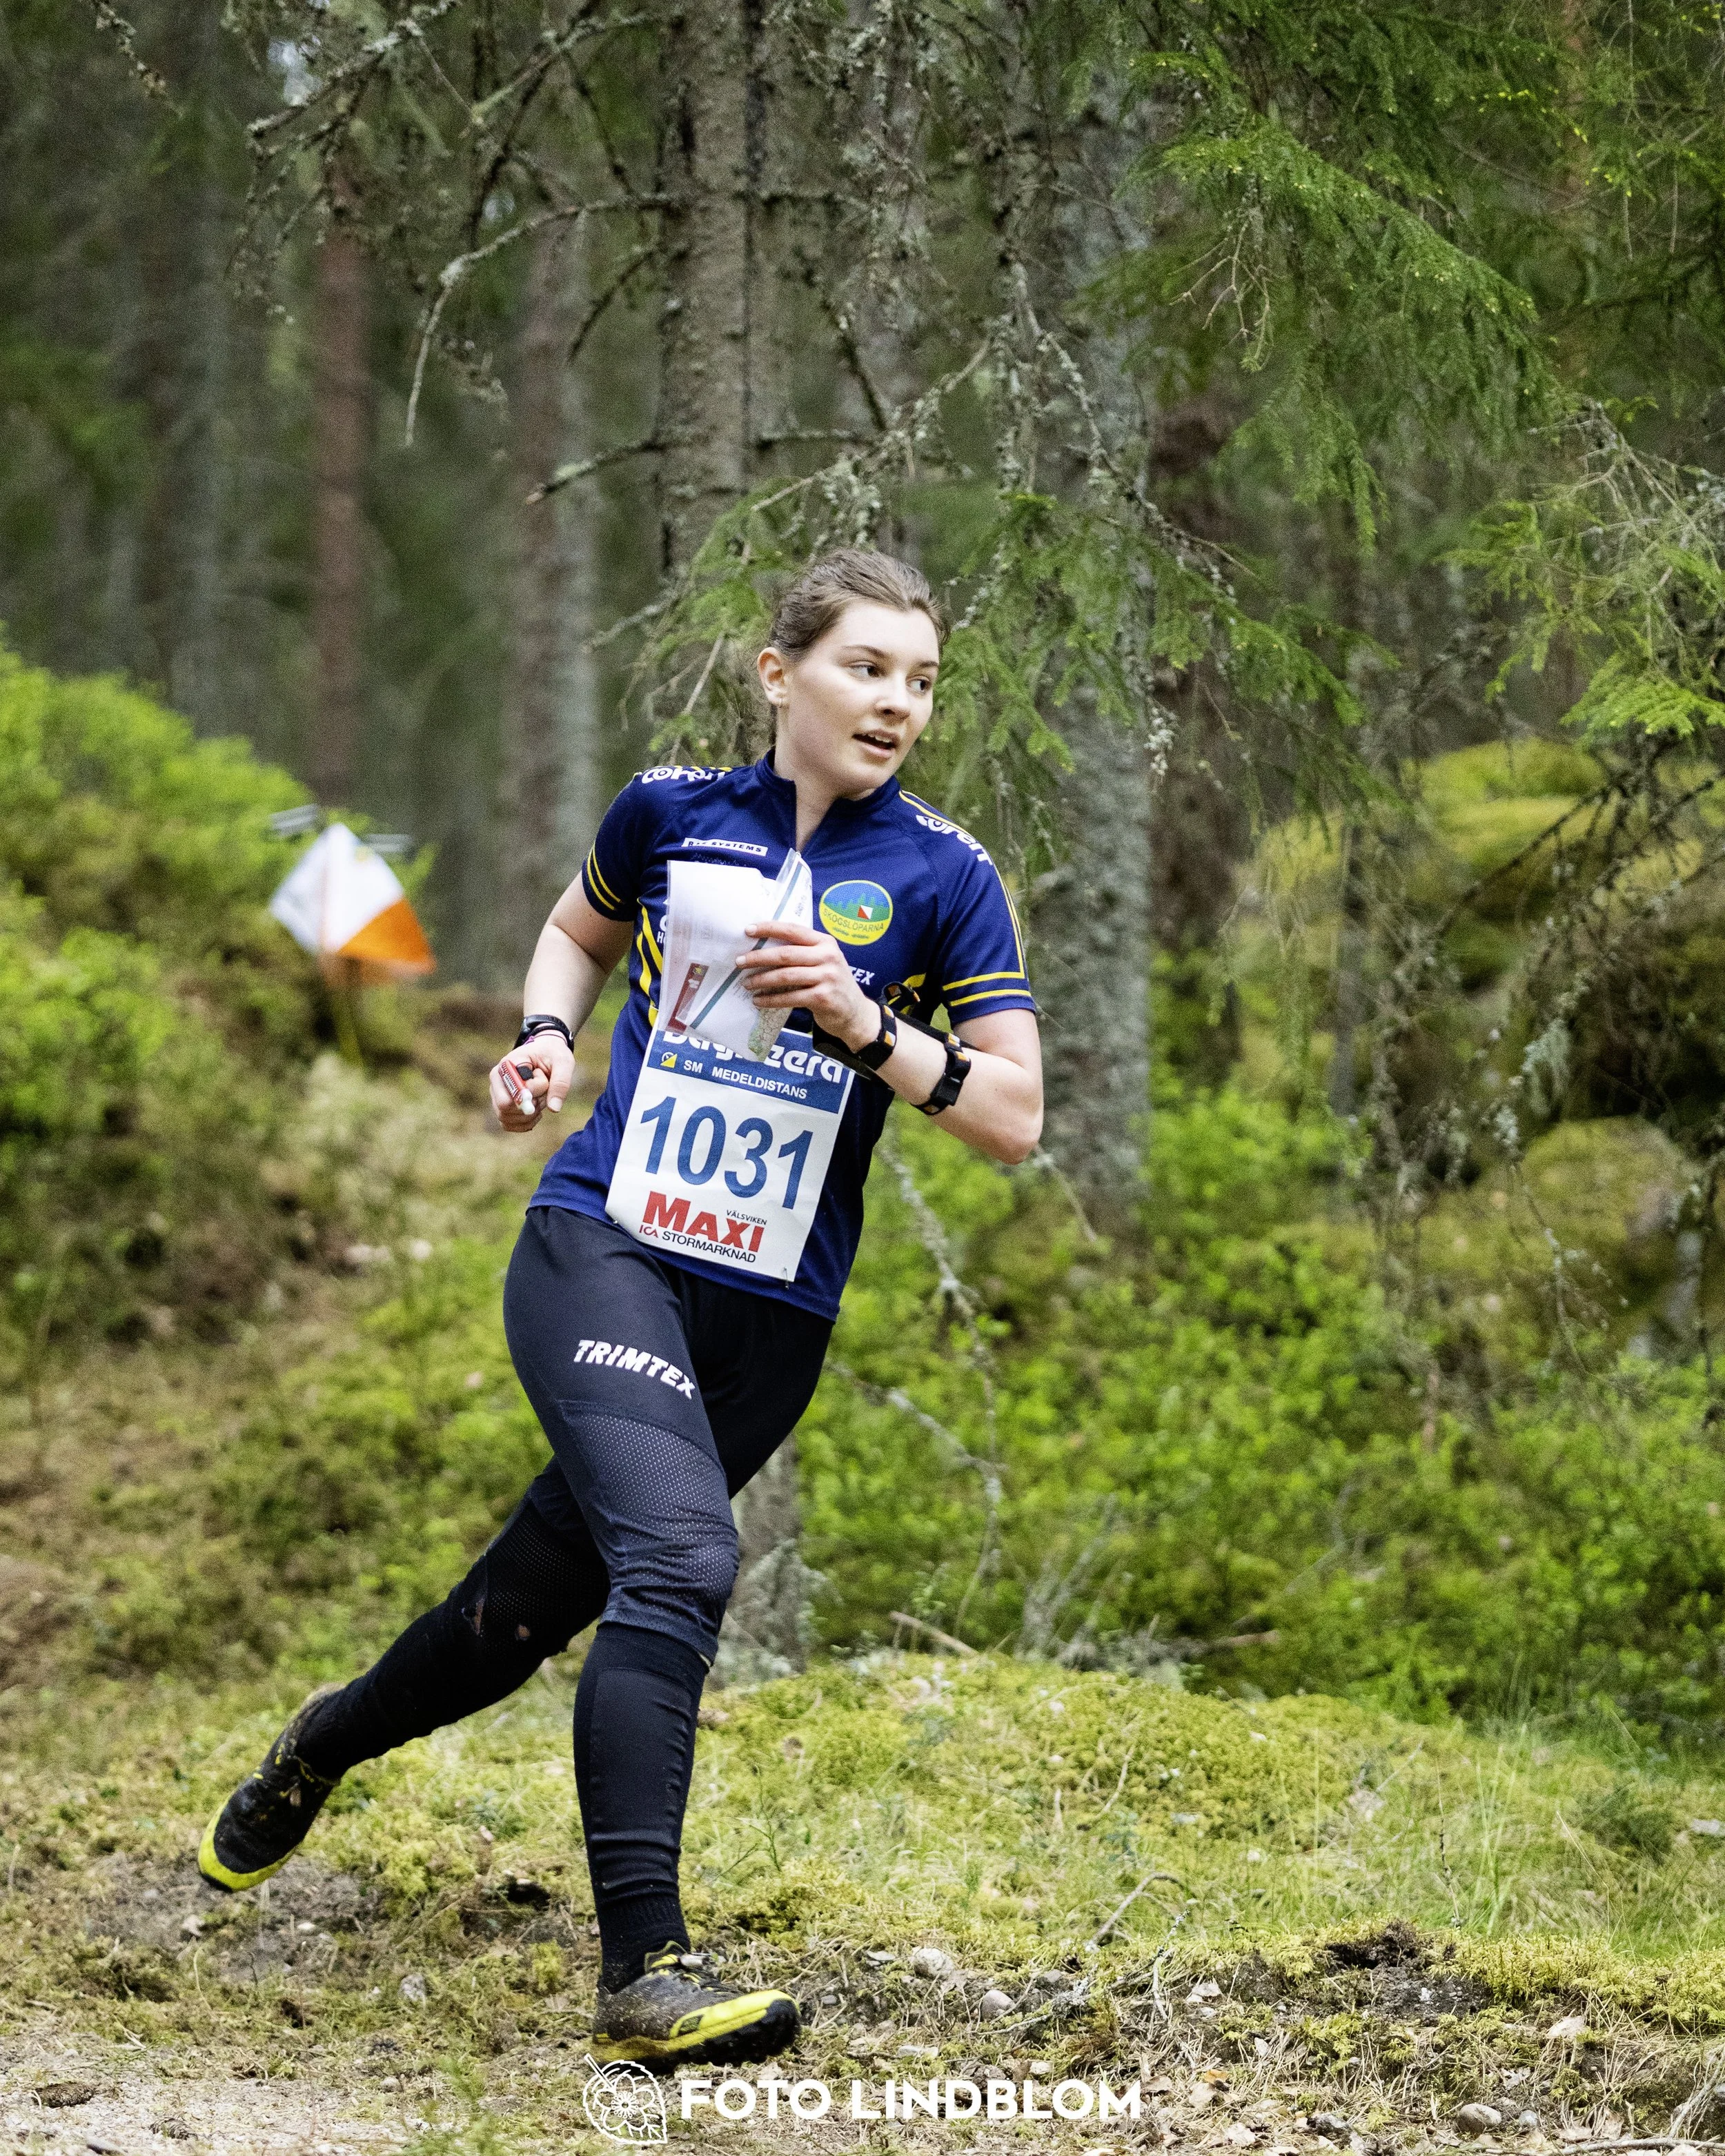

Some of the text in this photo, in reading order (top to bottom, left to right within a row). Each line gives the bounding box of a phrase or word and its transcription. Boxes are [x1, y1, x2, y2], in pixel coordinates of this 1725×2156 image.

[711, 841, 762, 853] SYSTEMS
[683, 1060, 807, 1099] SM MEDELDISTANS
[640, 1096, 814, 1210] 1031
[642, 1191, 765, 1253] MAXI
[726, 1209, 767, 1226] VÄLSVIKEN
[639, 1224, 756, 1263] ICA STORMARKNAD
[573, 1339, 696, 1400] TRIMTEX
